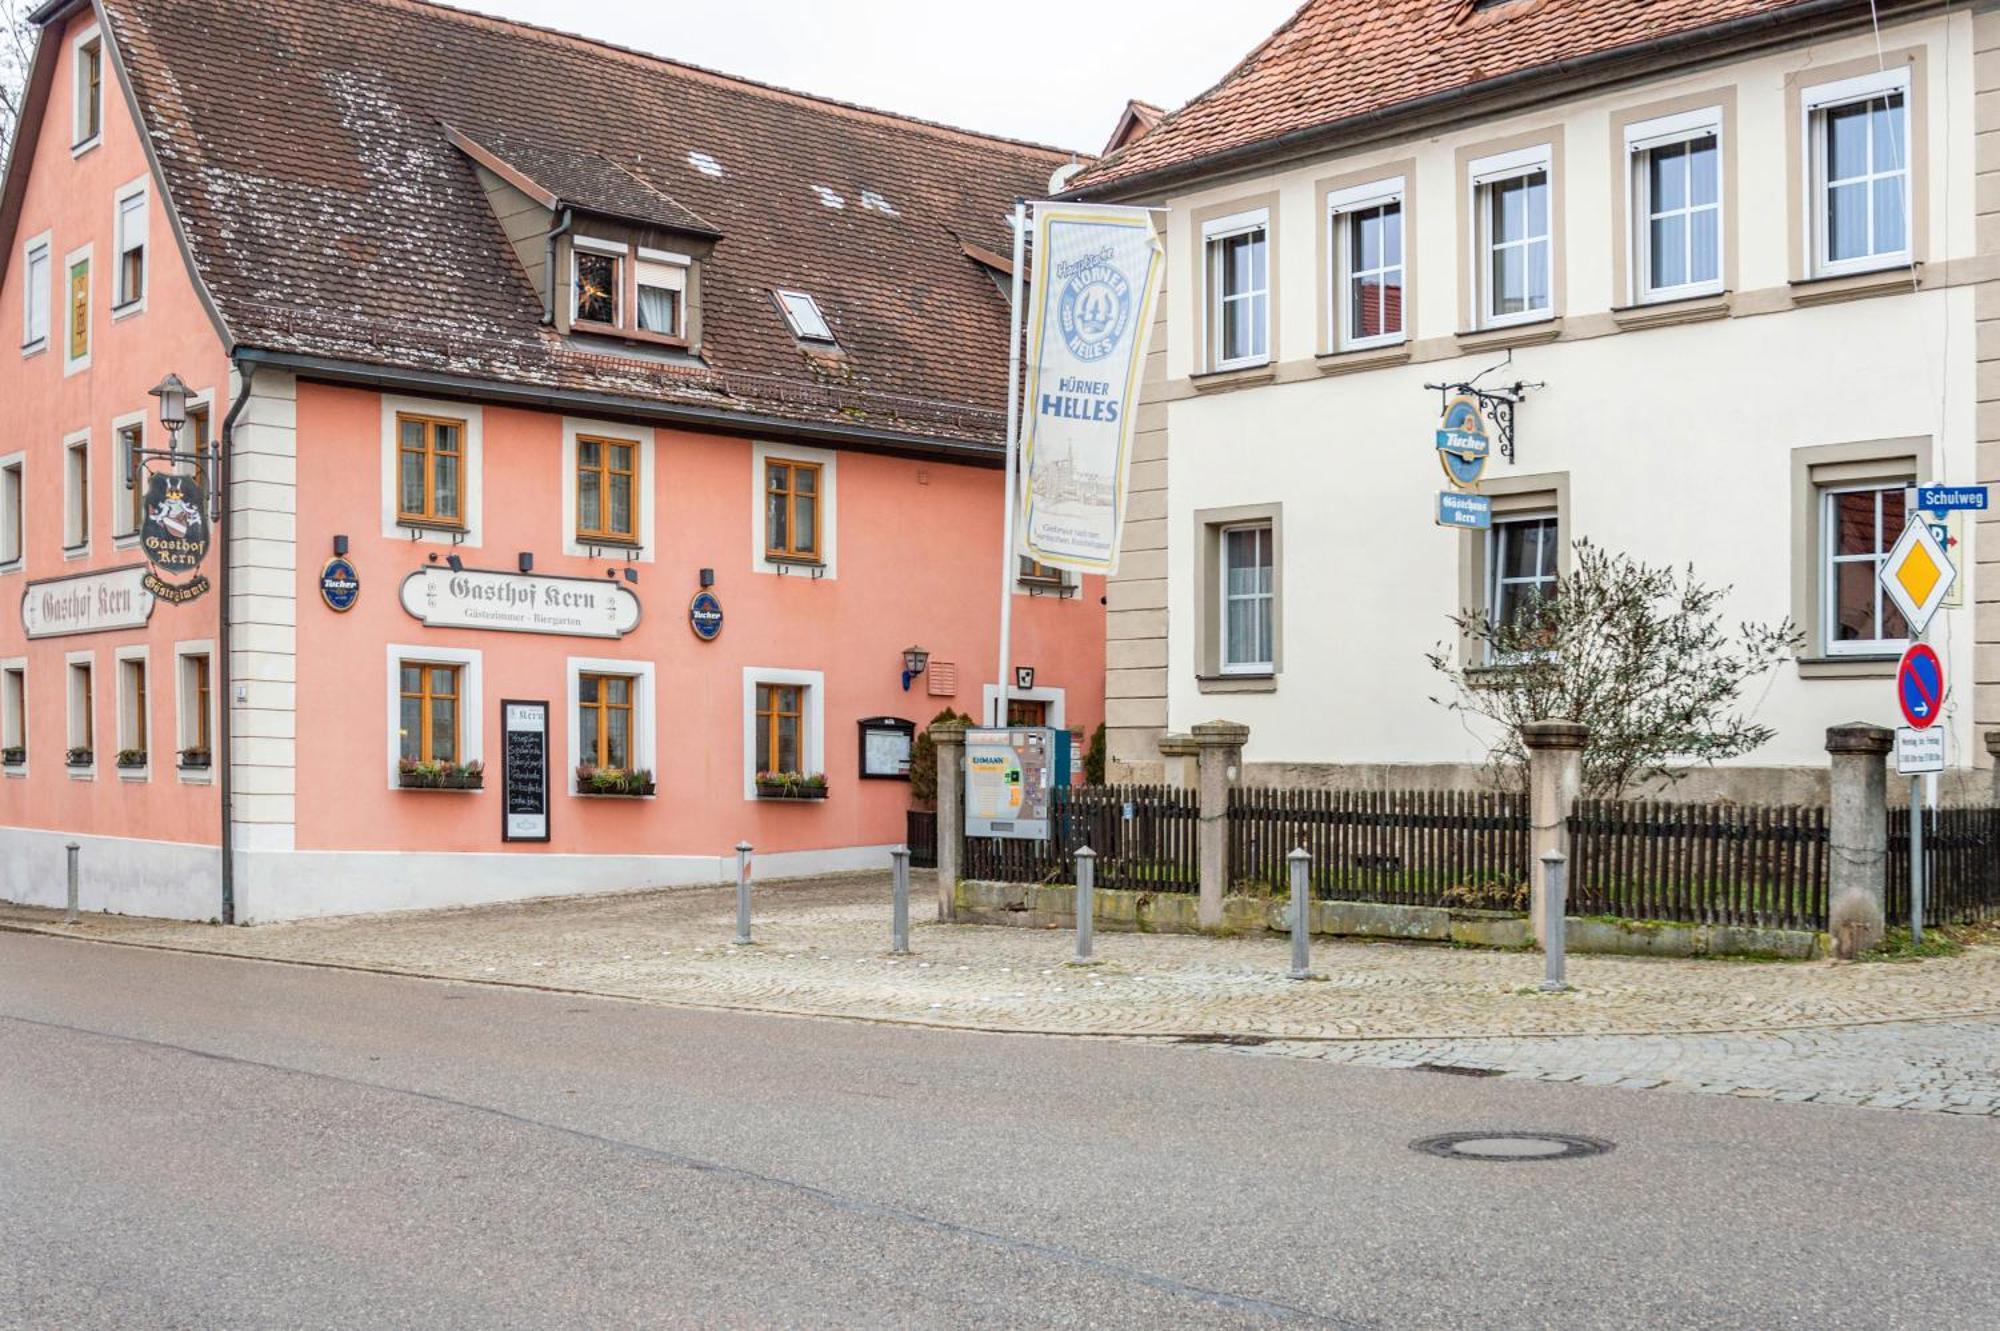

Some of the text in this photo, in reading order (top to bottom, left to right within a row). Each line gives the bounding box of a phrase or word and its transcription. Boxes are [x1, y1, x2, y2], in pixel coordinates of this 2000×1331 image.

[1060, 376, 1109, 395] HÜRNER
[1042, 394, 1119, 422] HELLES
[1446, 432, 1486, 450] Tucher
[1926, 490, 1984, 507] Schulweg
[146, 536, 205, 555] Gasthof
[158, 550, 195, 565] Kern
[324, 579, 357, 588] Tucher
[449, 577, 595, 609] Gasthof Kern
[42, 583, 130, 627] Gasthof Kern
[465, 608, 525, 622] Gästezimmer
[534, 613, 582, 626] Biergarten
[693, 610, 721, 619] Tucher
